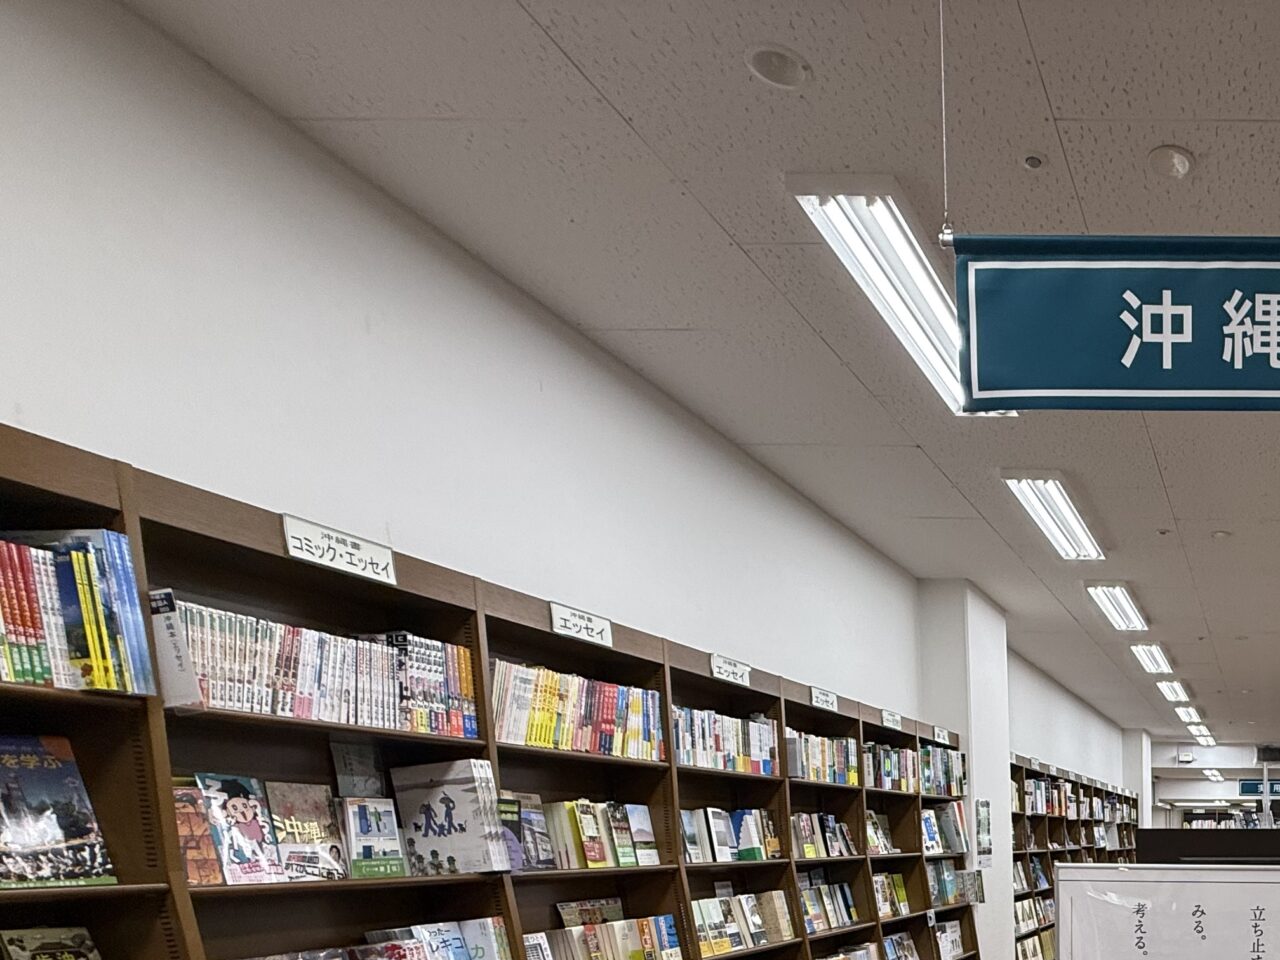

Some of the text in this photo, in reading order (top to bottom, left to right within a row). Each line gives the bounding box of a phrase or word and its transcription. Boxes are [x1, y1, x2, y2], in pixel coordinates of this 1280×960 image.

[291, 535, 390, 579] コミック・エッセイ
[559, 617, 605, 641] エッセイ
[716, 665, 745, 682] エッセイ
[1132, 902, 1148, 955] 考える。
[1191, 904, 1206, 940] みる。
